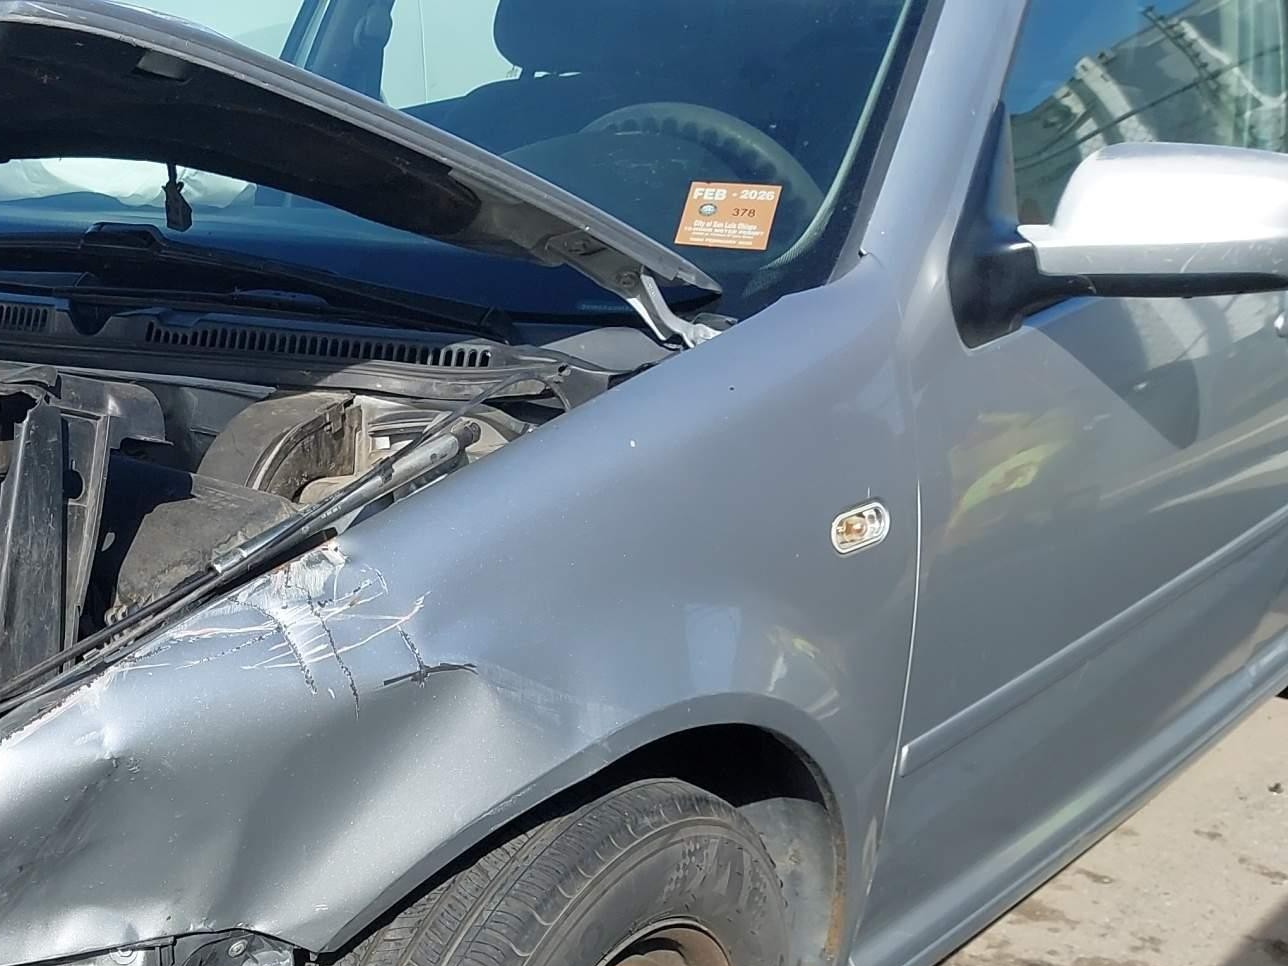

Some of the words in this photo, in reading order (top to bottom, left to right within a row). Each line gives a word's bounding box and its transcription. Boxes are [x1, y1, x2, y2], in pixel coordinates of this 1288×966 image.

[693, 188, 727, 200] FEB
[739, 190, 775, 201] 2026
[732, 208, 756, 218] 378
[694, 220, 705, 228] City
[724, 221, 737, 229] Luis
